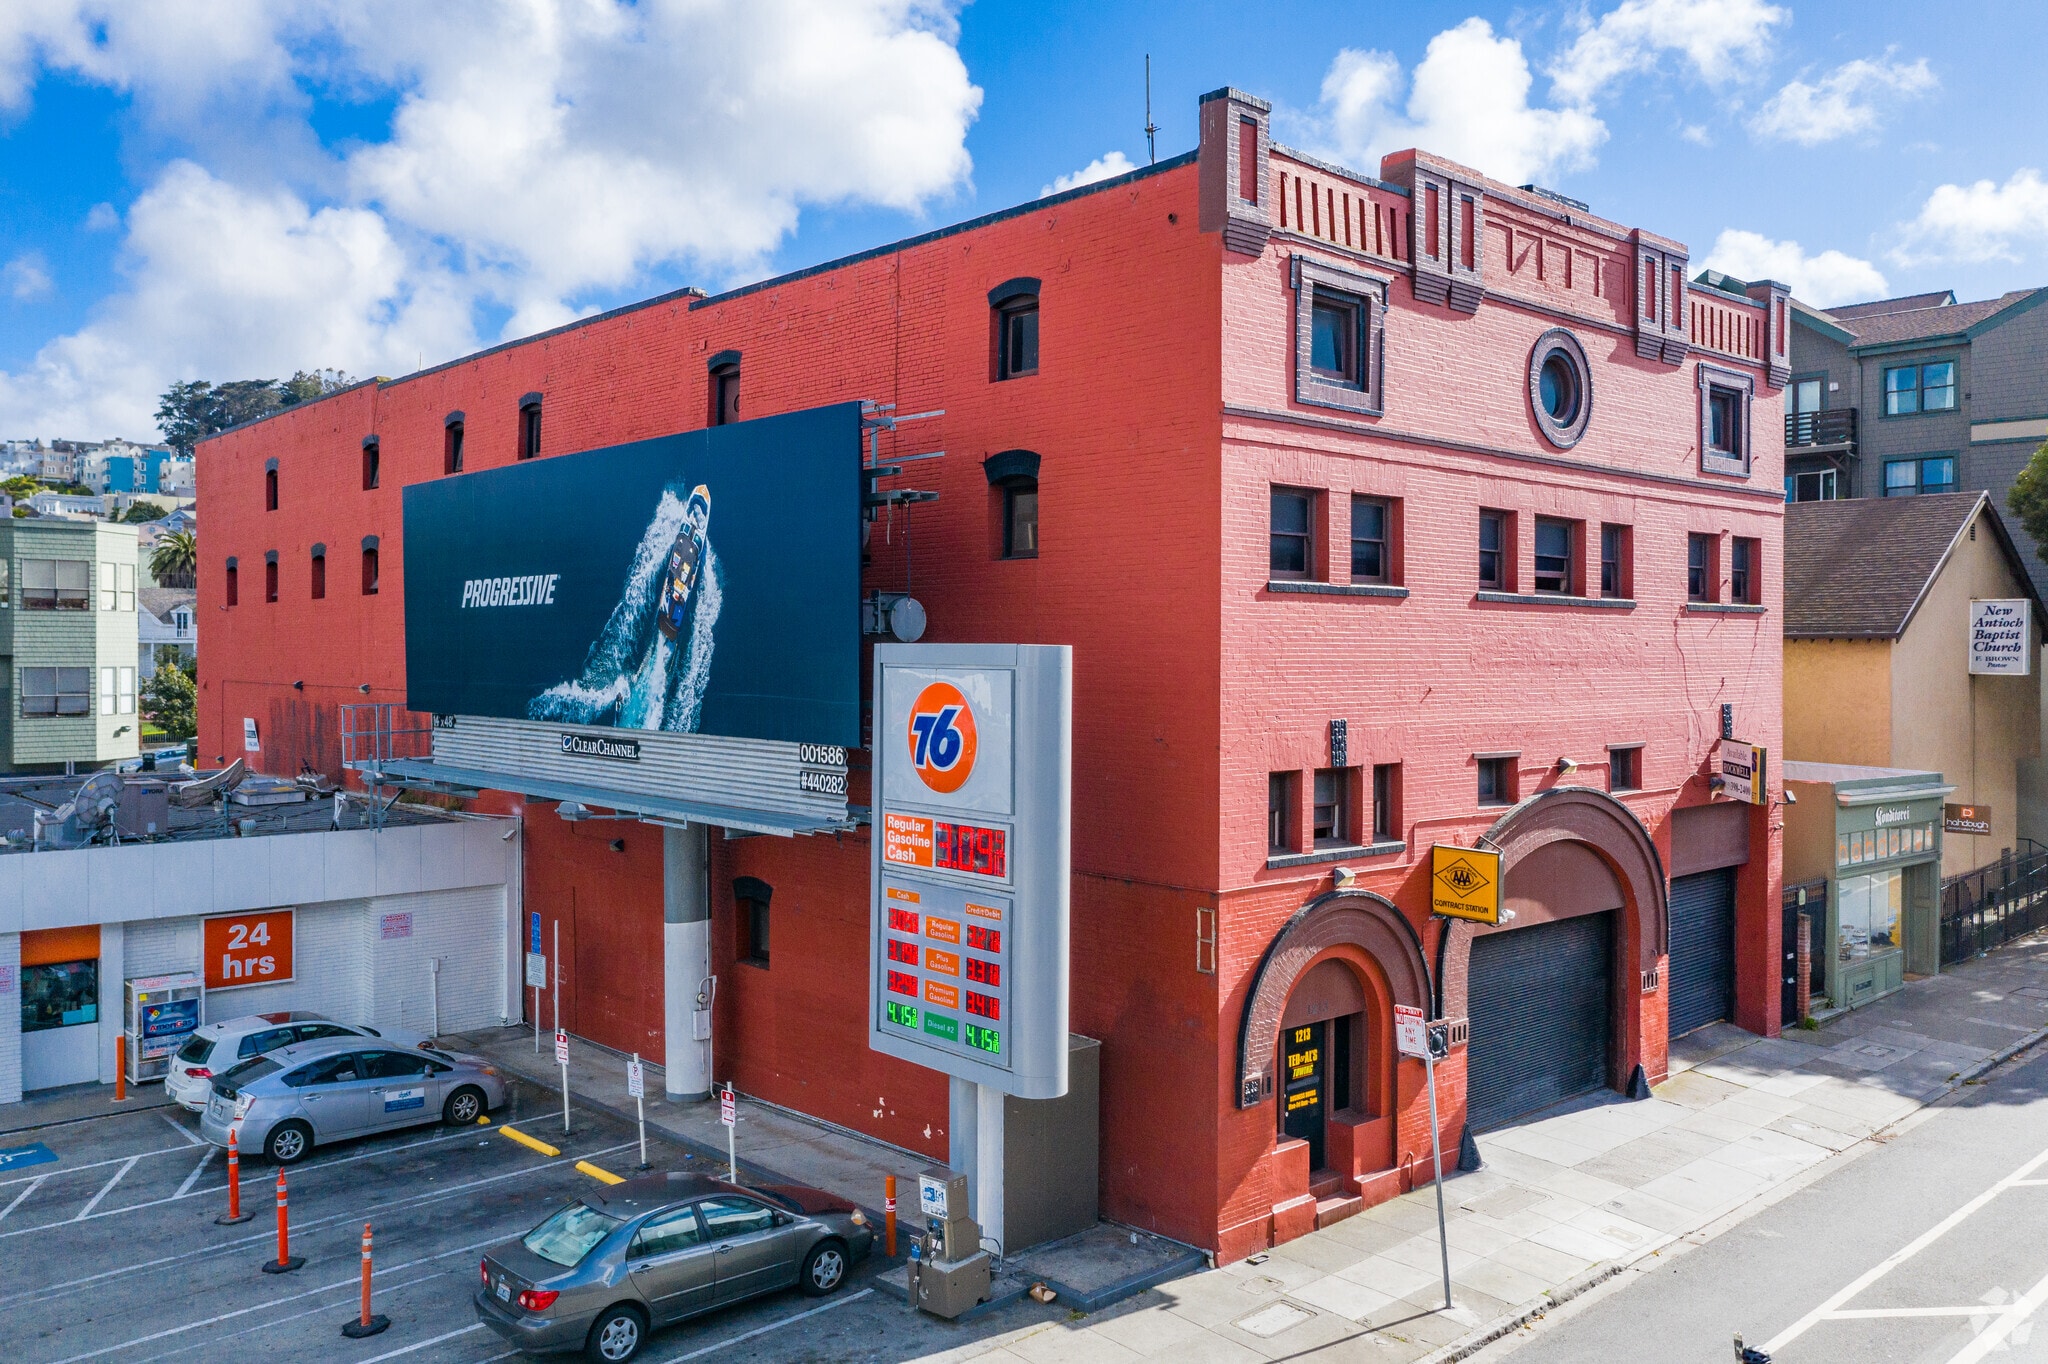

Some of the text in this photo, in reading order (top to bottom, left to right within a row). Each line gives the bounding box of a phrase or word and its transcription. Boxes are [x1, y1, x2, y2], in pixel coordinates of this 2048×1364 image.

[461, 574, 558, 608] PROGRESSIVE
[1984, 605, 2013, 615] New
[1973, 617, 2023, 628] Antioch
[1974, 629, 2020, 643] Baptist
[1973, 641, 2021, 652] Church
[911, 704, 964, 772] 76
[801, 744, 844, 765] 001586
[1727, 748, 1747, 760] Available
[1723, 762, 1750, 779] ROCKWELL
[801, 771, 844, 794] #440282
[887, 816, 925, 832] Regular
[1946, 818, 1989, 829] hahdough
[887, 830, 930, 848] Gasoline
[887, 845, 916, 862] Cash
[1453, 870, 1471, 886] AAA
[897, 891, 910, 900] Cash
[1434, 899, 1489, 914] CONTRACT STATION
[931, 920, 954, 931] Regular
[228, 922, 271, 950] 24
[930, 929, 955, 940] Gasoline
[936, 954, 949, 963] Plus
[223, 954, 275, 979] hrs
[930, 961, 954, 972] Gasoline
[928, 984, 954, 997] Premium
[929, 992, 954, 1005] Gasoline
[928, 1019, 954, 1034] Diesel #2
[1295, 1027, 1311, 1043] 1213
[1405, 1035, 1417, 1045] TIME
[1293, 1064, 1314, 1078] TOWING
